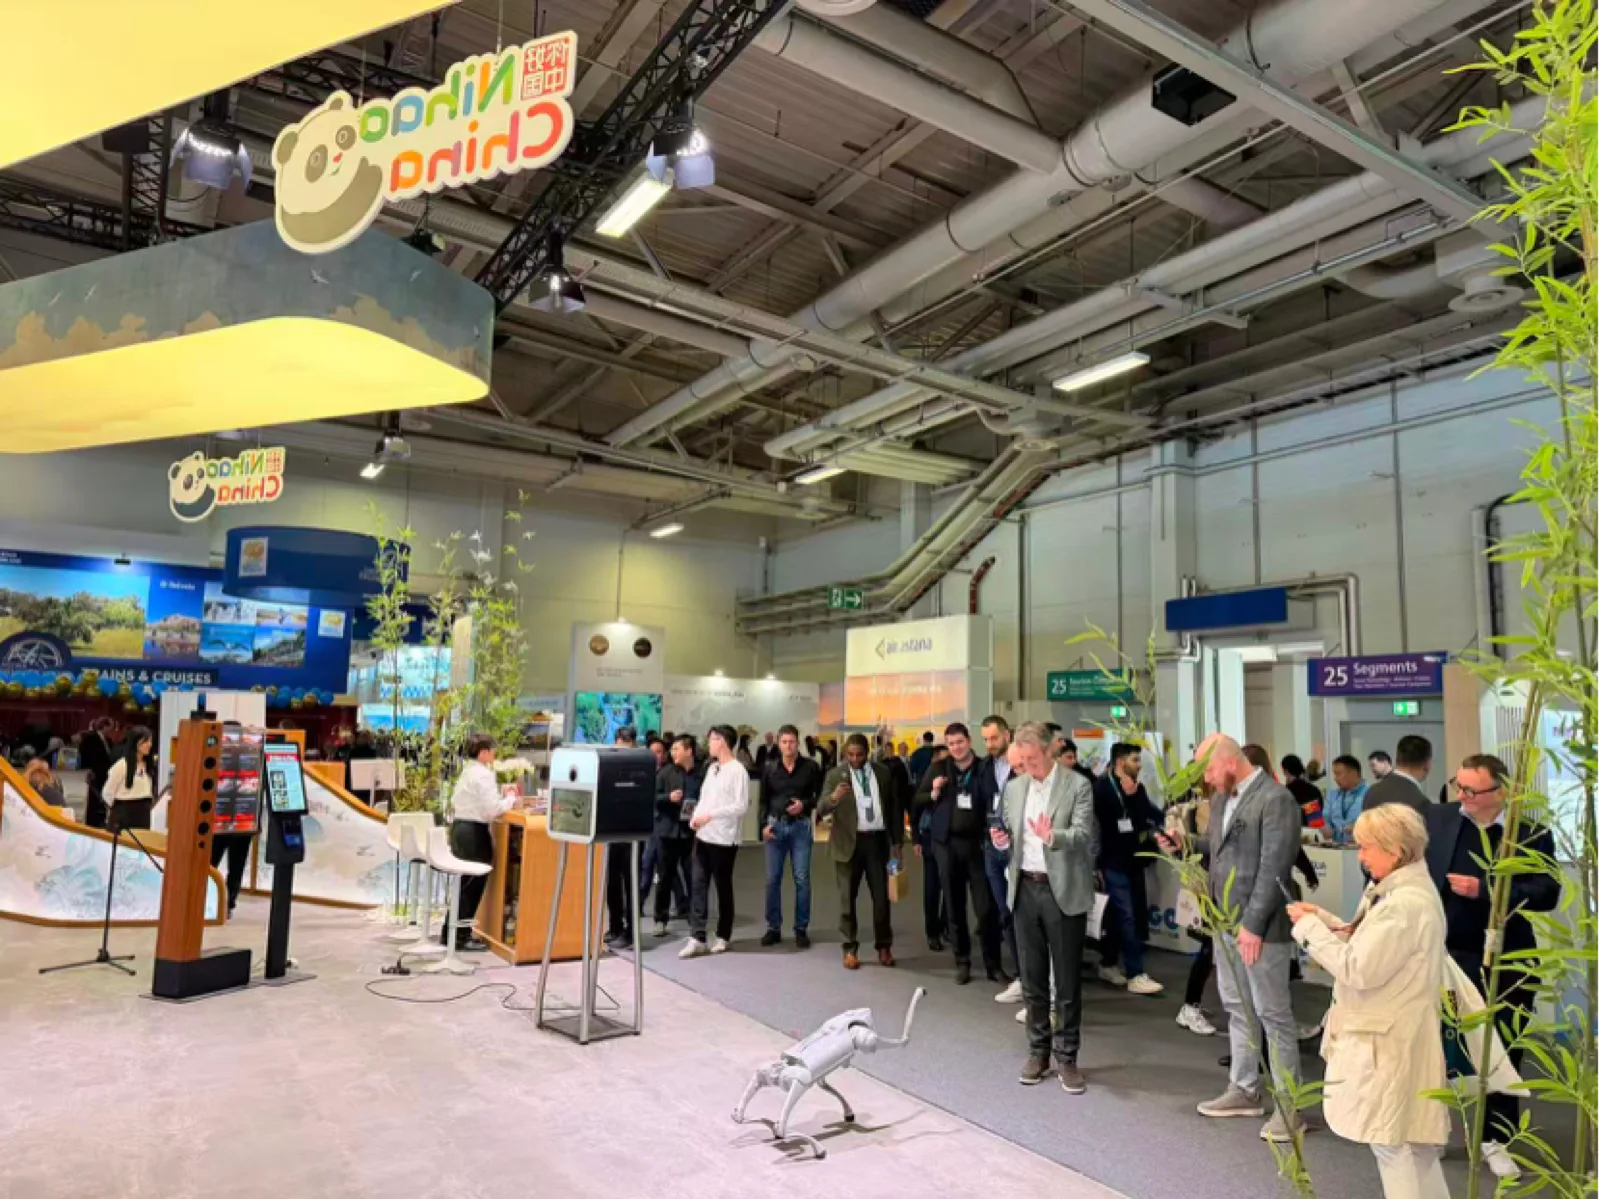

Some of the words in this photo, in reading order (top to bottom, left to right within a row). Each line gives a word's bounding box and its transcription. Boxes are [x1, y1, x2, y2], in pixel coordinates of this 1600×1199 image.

[138, 669, 149, 681] &
[152, 670, 212, 685] CRUISES
[1324, 665, 1348, 687] 25
[1353, 660, 1418, 677] Segments
[1052, 678, 1067, 695] 25
